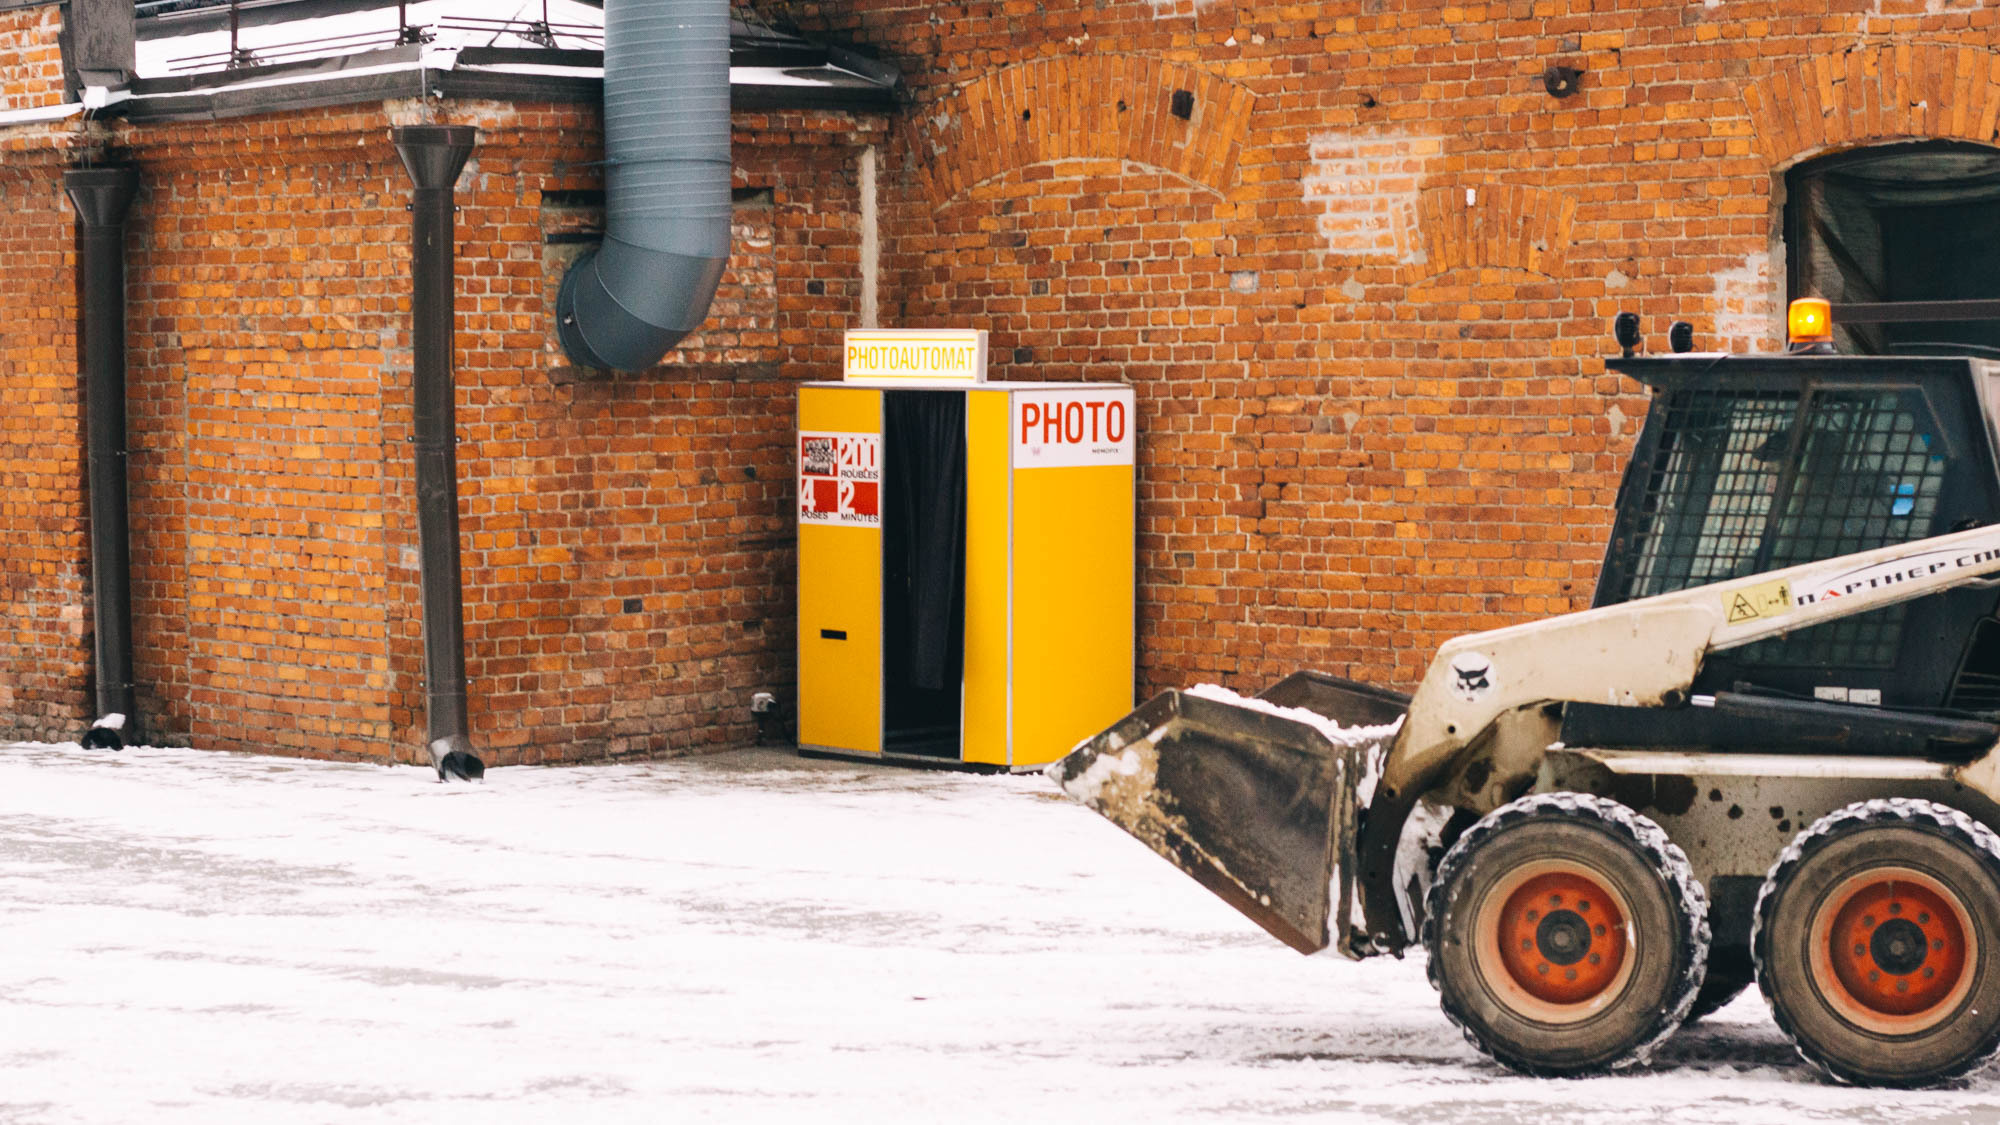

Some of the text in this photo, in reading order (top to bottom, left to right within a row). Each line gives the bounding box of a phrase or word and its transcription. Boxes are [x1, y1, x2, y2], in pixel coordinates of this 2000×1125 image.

[848, 346, 975, 370] PHOTOAUTOMAT
[1022, 400, 1125, 444] PHOTO
[841, 437, 878, 470] 200
[841, 470, 878, 479] ROUBLES
[801, 479, 816, 512] 4
[841, 481, 855, 514] 2
[801, 510, 829, 520] POSES
[841, 512, 879, 523] MINUTES
[1797, 562, 1946, 605] ПАРТНЕР
